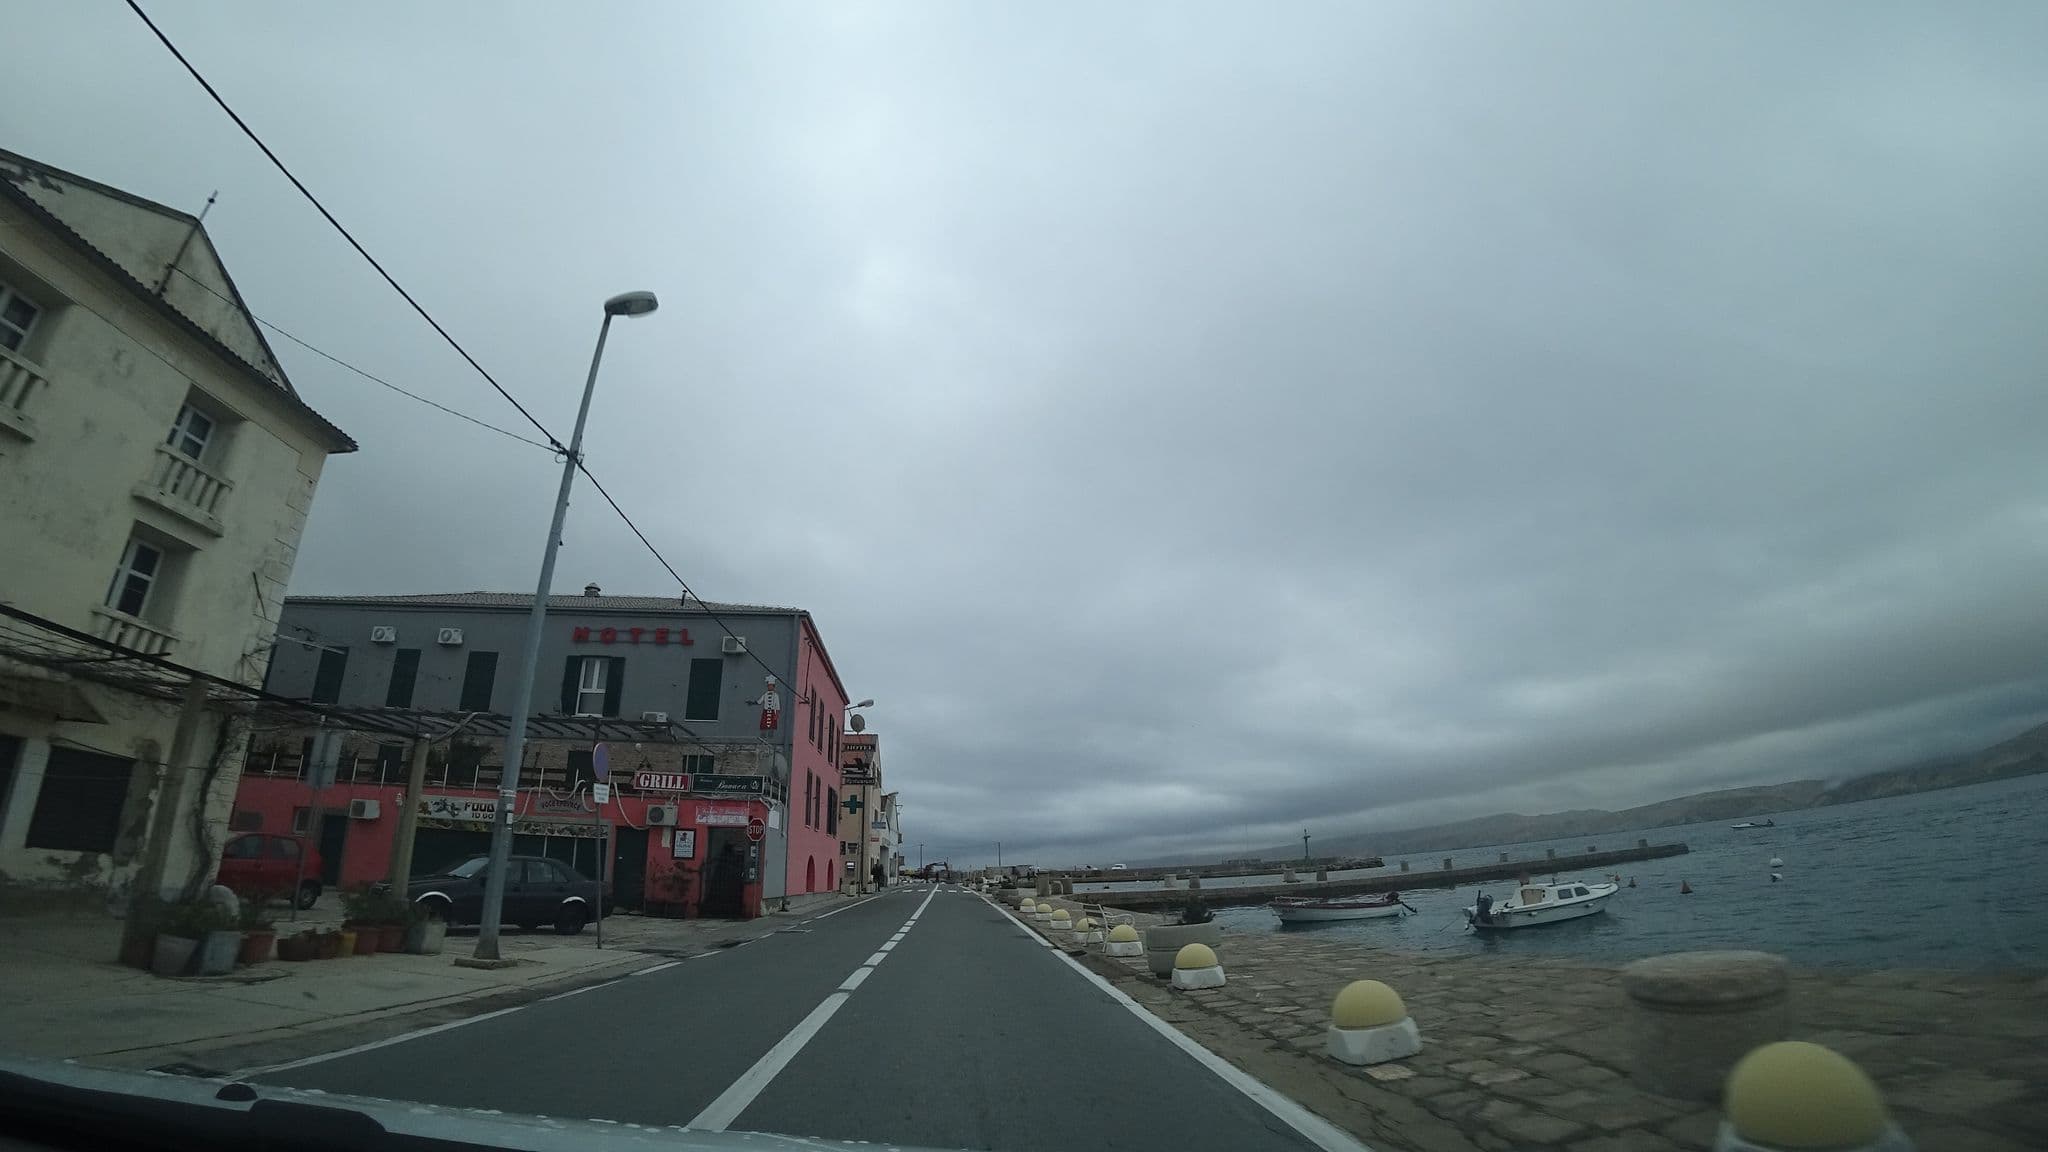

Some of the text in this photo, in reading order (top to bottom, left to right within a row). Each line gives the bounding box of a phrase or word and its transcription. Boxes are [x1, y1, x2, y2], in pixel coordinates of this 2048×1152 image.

[572, 627, 694, 645] HOTEL
[640, 773, 685, 789] GRILL
[464, 801, 495, 812] FOOD
[749, 825, 763, 834] STOP
